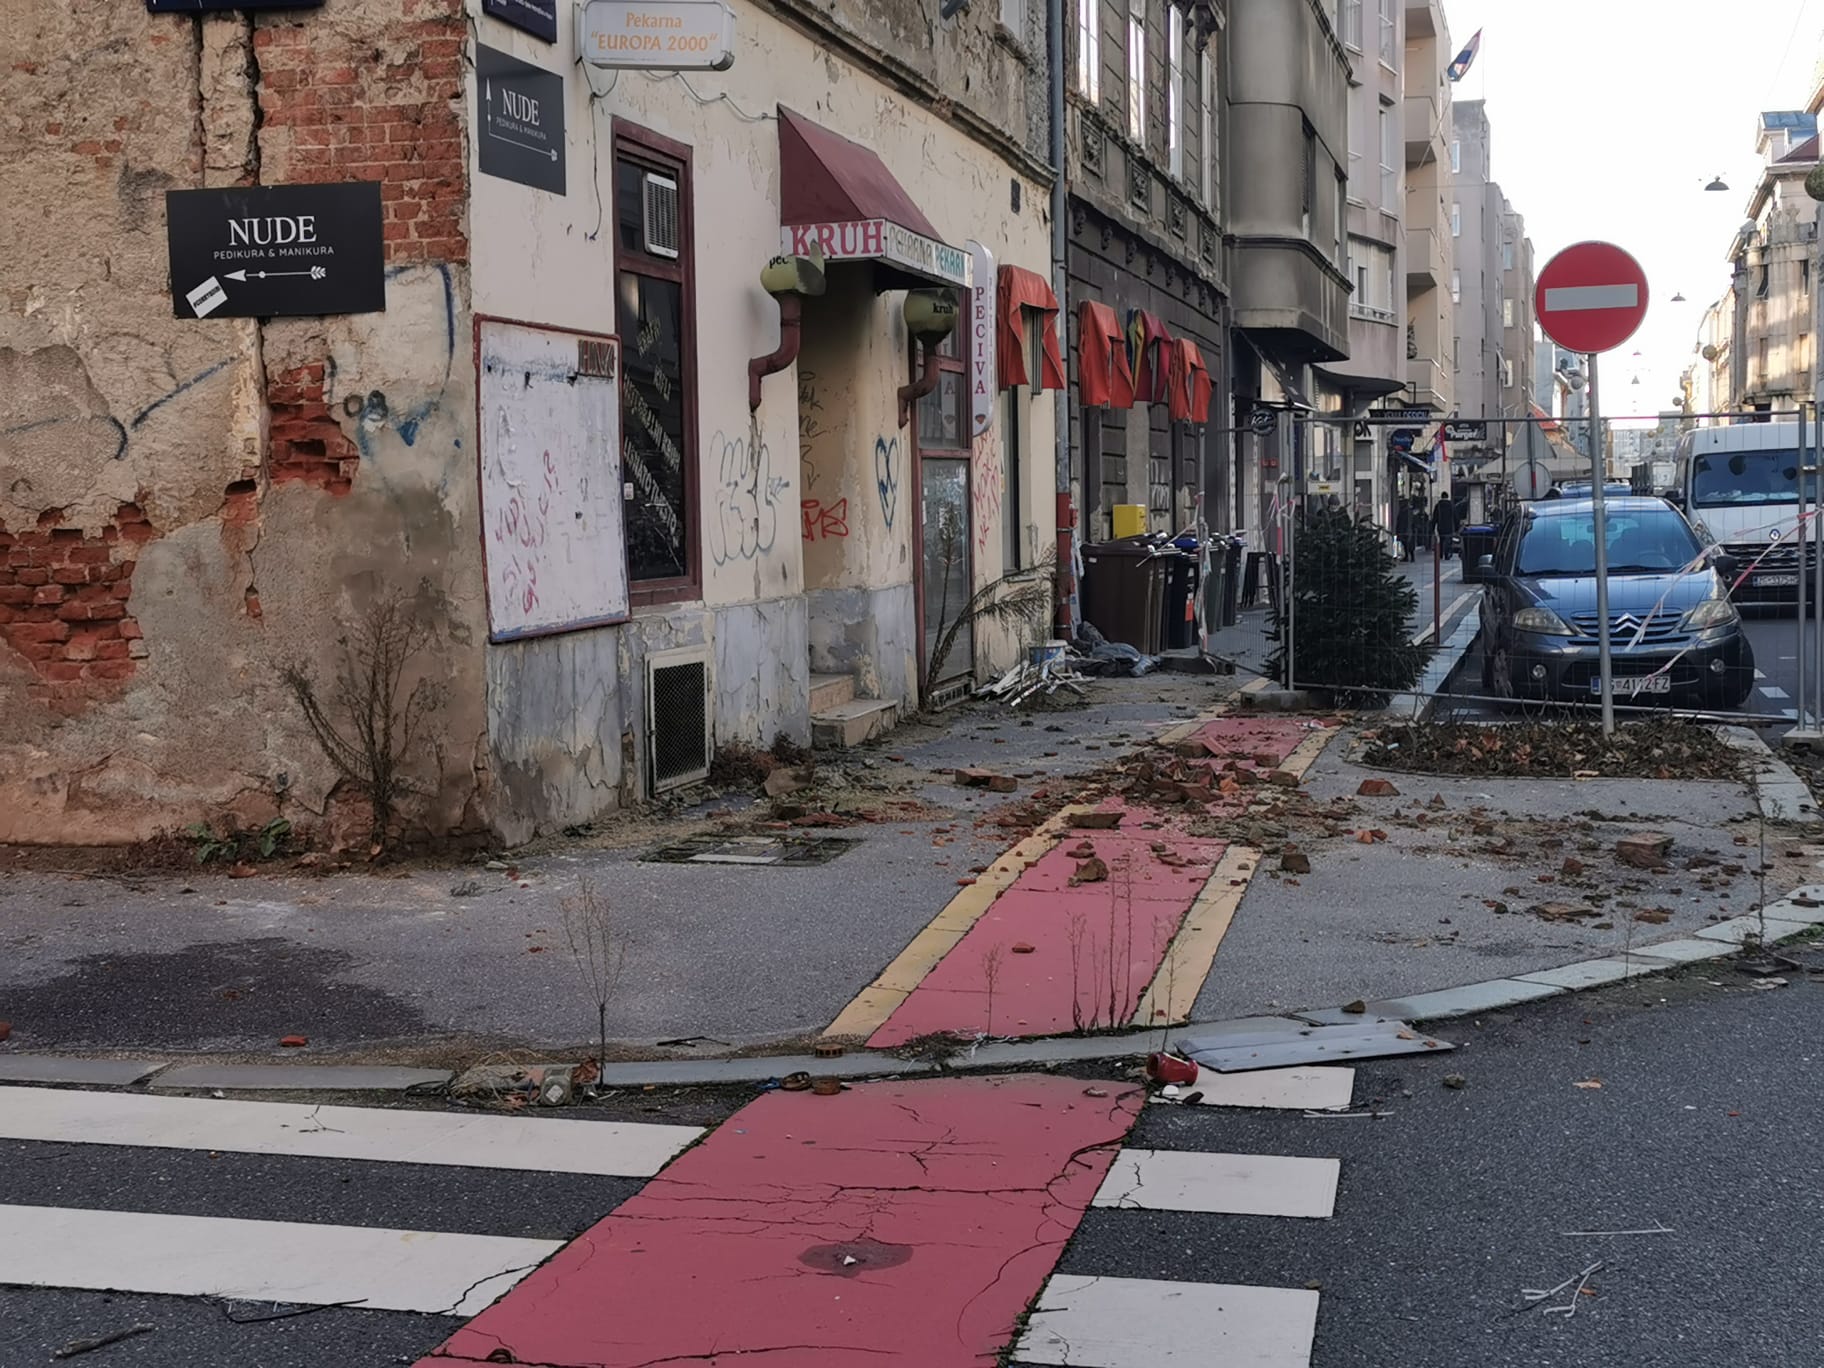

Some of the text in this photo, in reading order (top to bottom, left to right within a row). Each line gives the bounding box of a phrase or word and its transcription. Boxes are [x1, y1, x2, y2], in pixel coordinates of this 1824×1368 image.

[626, 12, 682, 28] Pekarna
[502, 87, 540, 127] NUDE
[228, 215, 318, 246] NUDE
[789, 220, 885, 257] KRUH
[214, 246, 335, 260] PEDIKURA & MANIKURA
[932, 303, 954, 315] kruh
[974, 286, 986, 395] PECIVA
